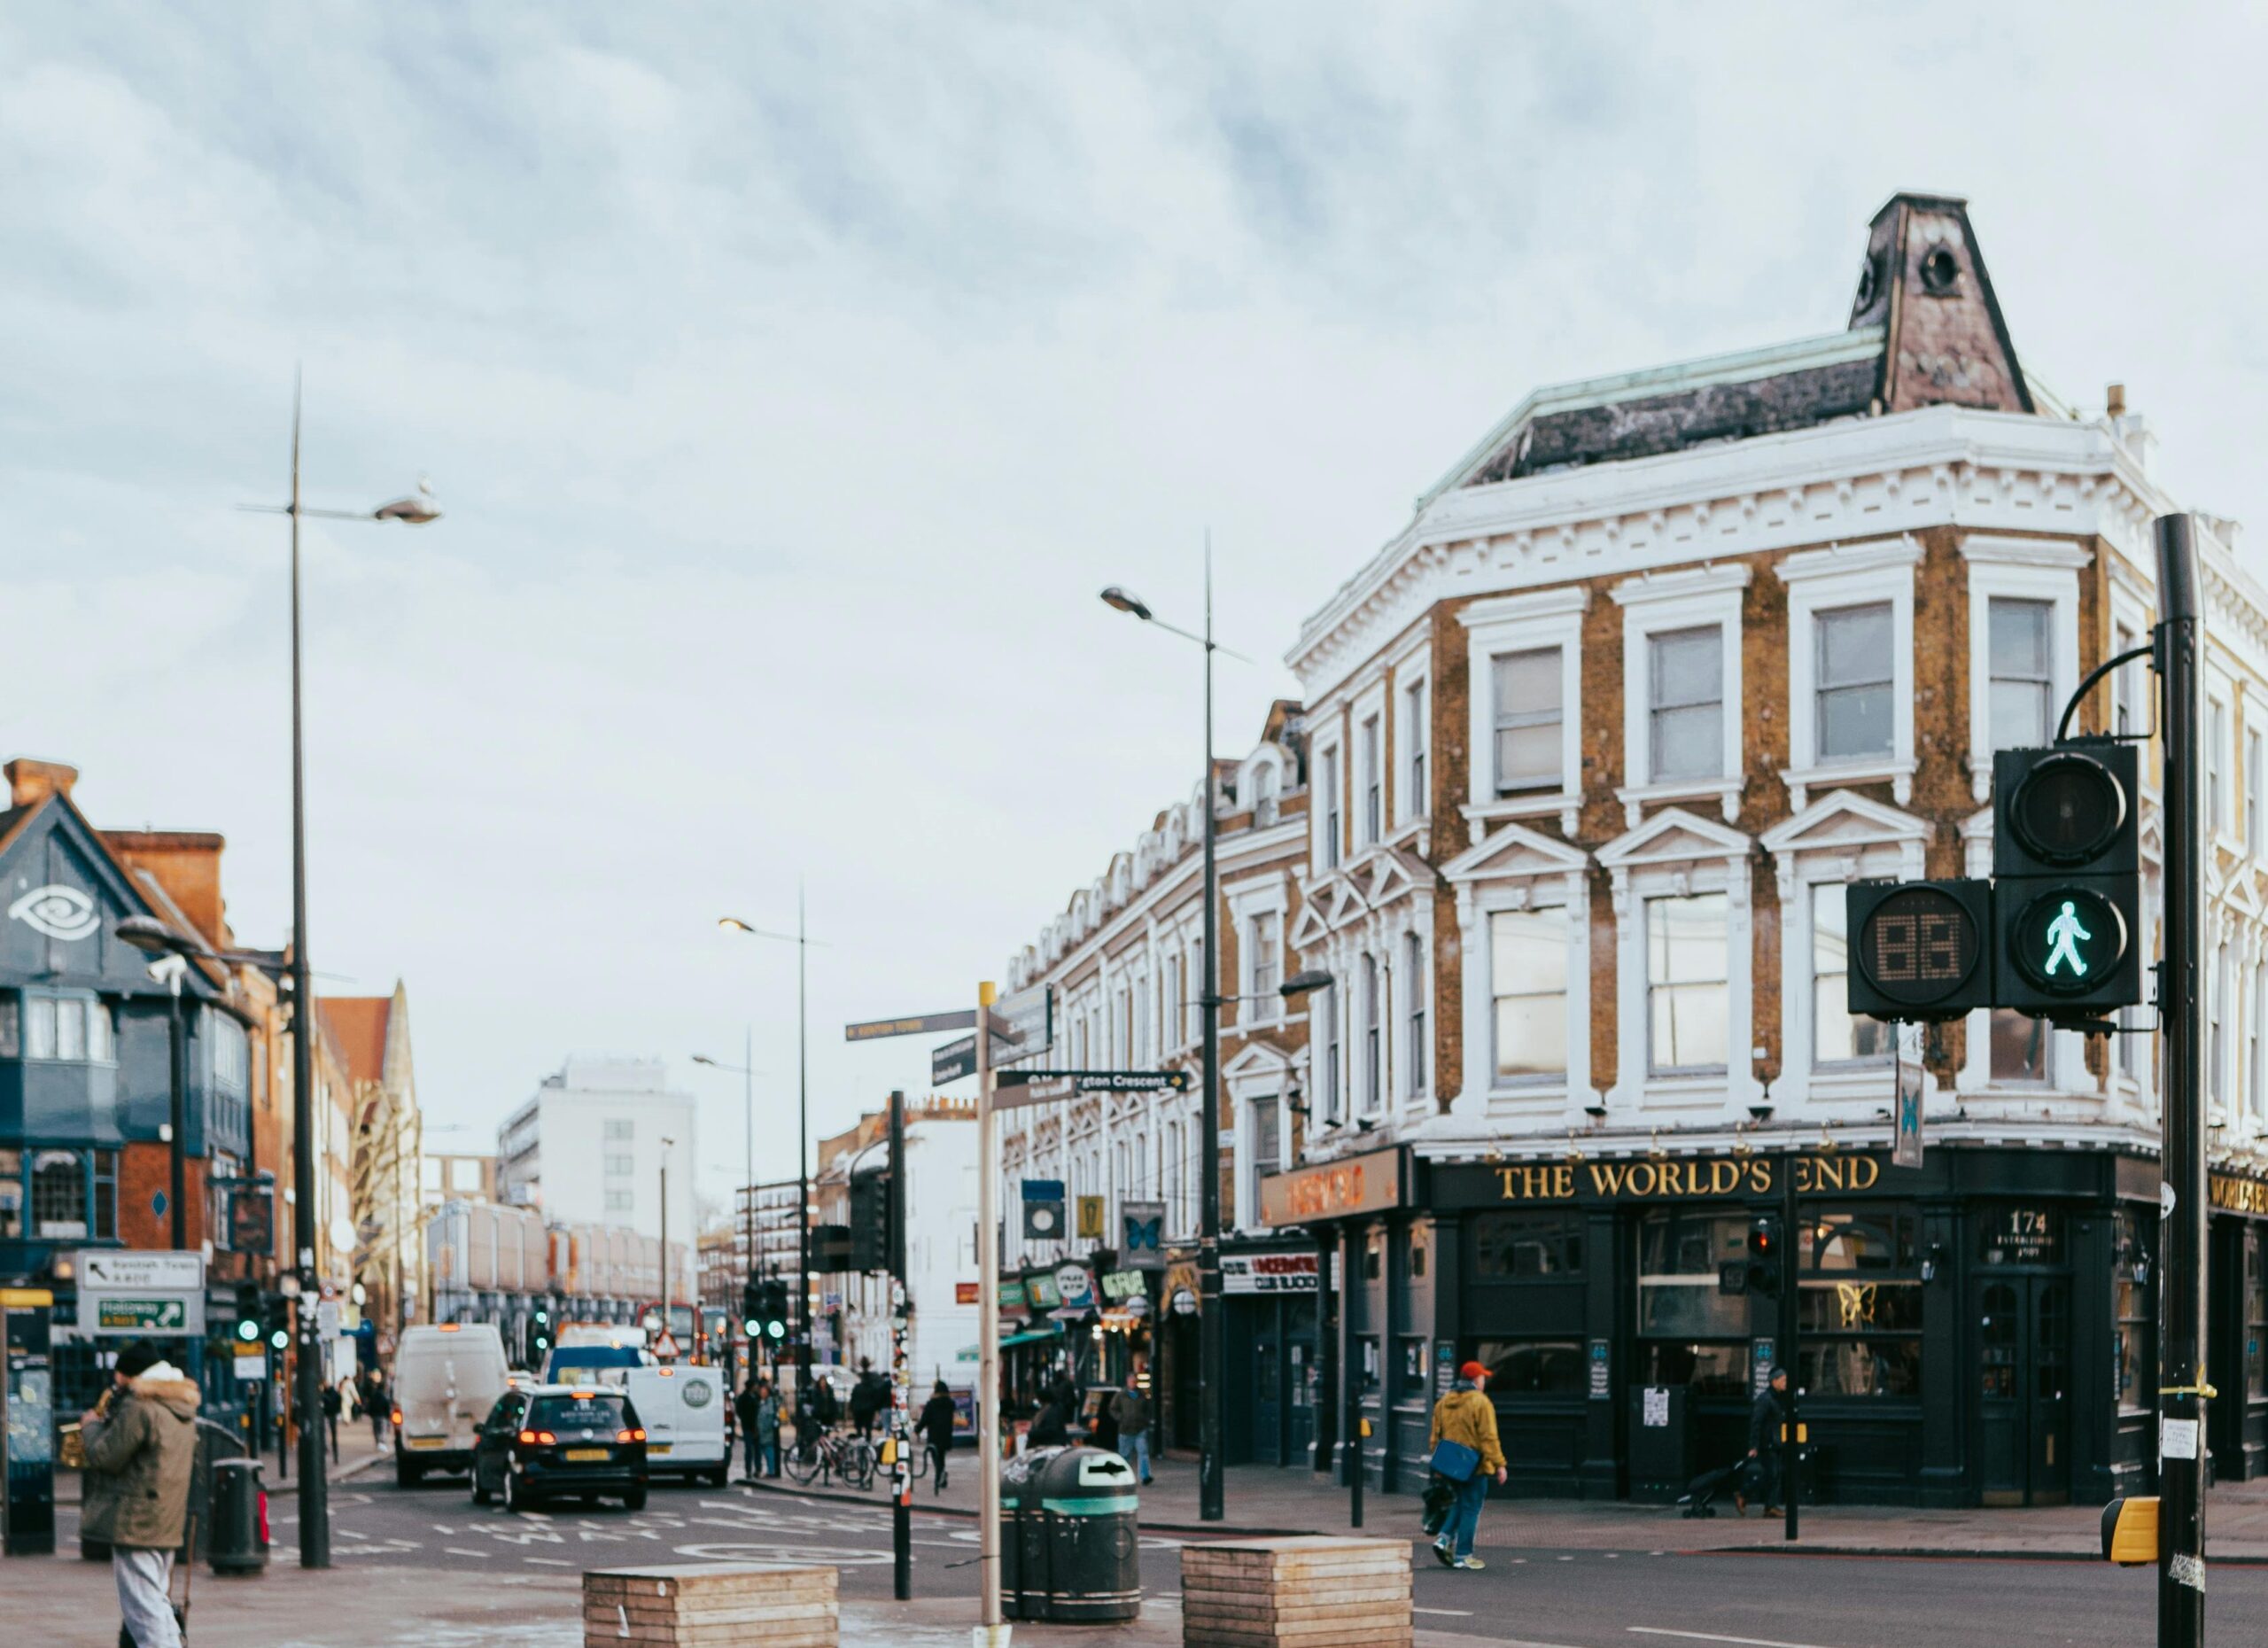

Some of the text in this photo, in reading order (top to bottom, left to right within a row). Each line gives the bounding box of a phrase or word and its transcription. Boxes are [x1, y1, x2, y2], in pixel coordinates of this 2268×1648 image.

[1113, 1075, 1168, 1088] Crescent
[1494, 1156, 1879, 1199] THE WORLD'S END
[2010, 1209, 2047, 1234] 174
